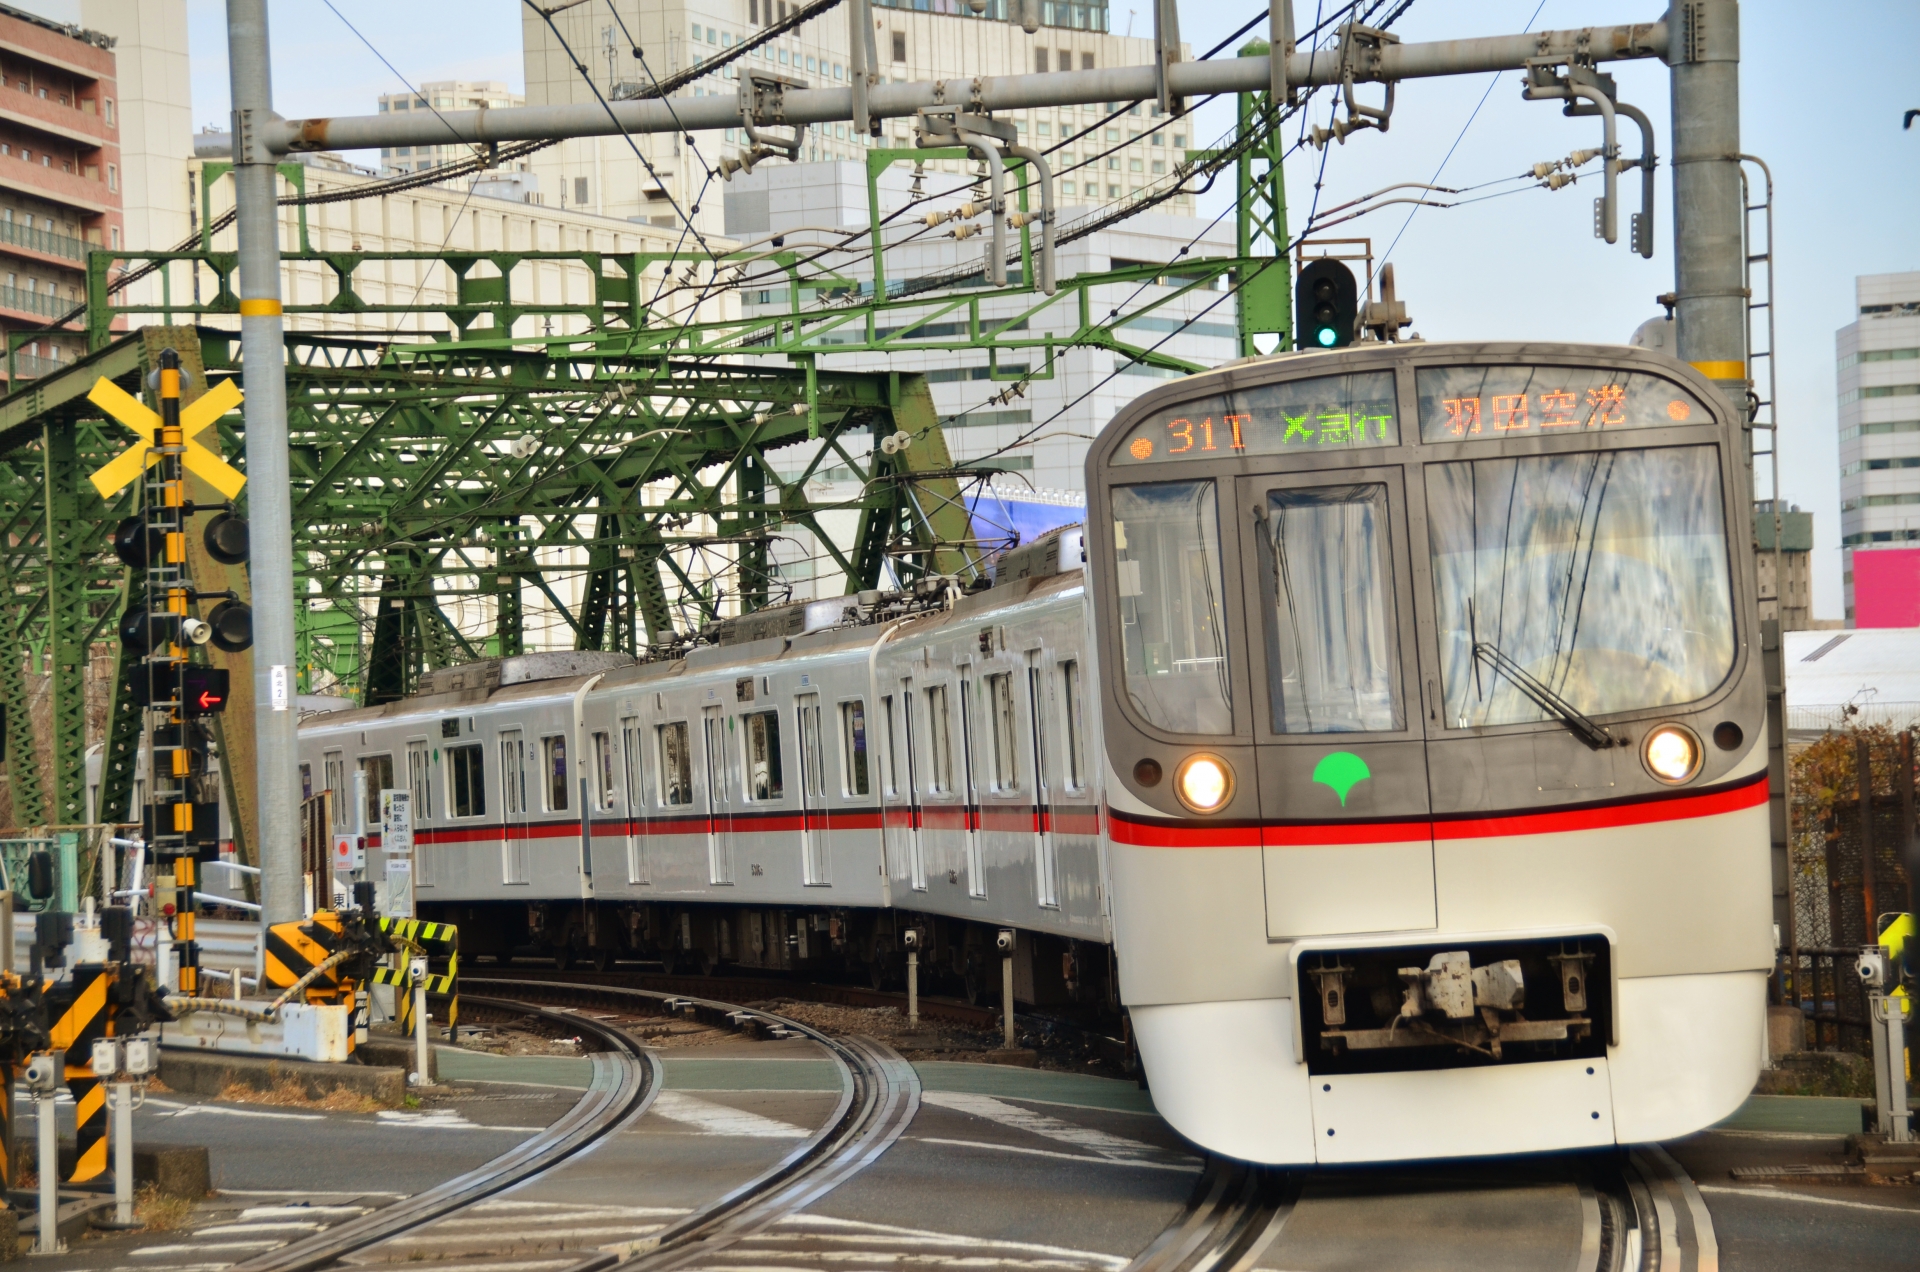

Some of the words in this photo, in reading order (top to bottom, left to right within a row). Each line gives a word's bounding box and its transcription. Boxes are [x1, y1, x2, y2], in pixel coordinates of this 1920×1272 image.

[1167, 414, 1252, 453] 31T
[1315, 403, 1393, 445] 急行
[1442, 384, 1627, 436] 羽田空港
